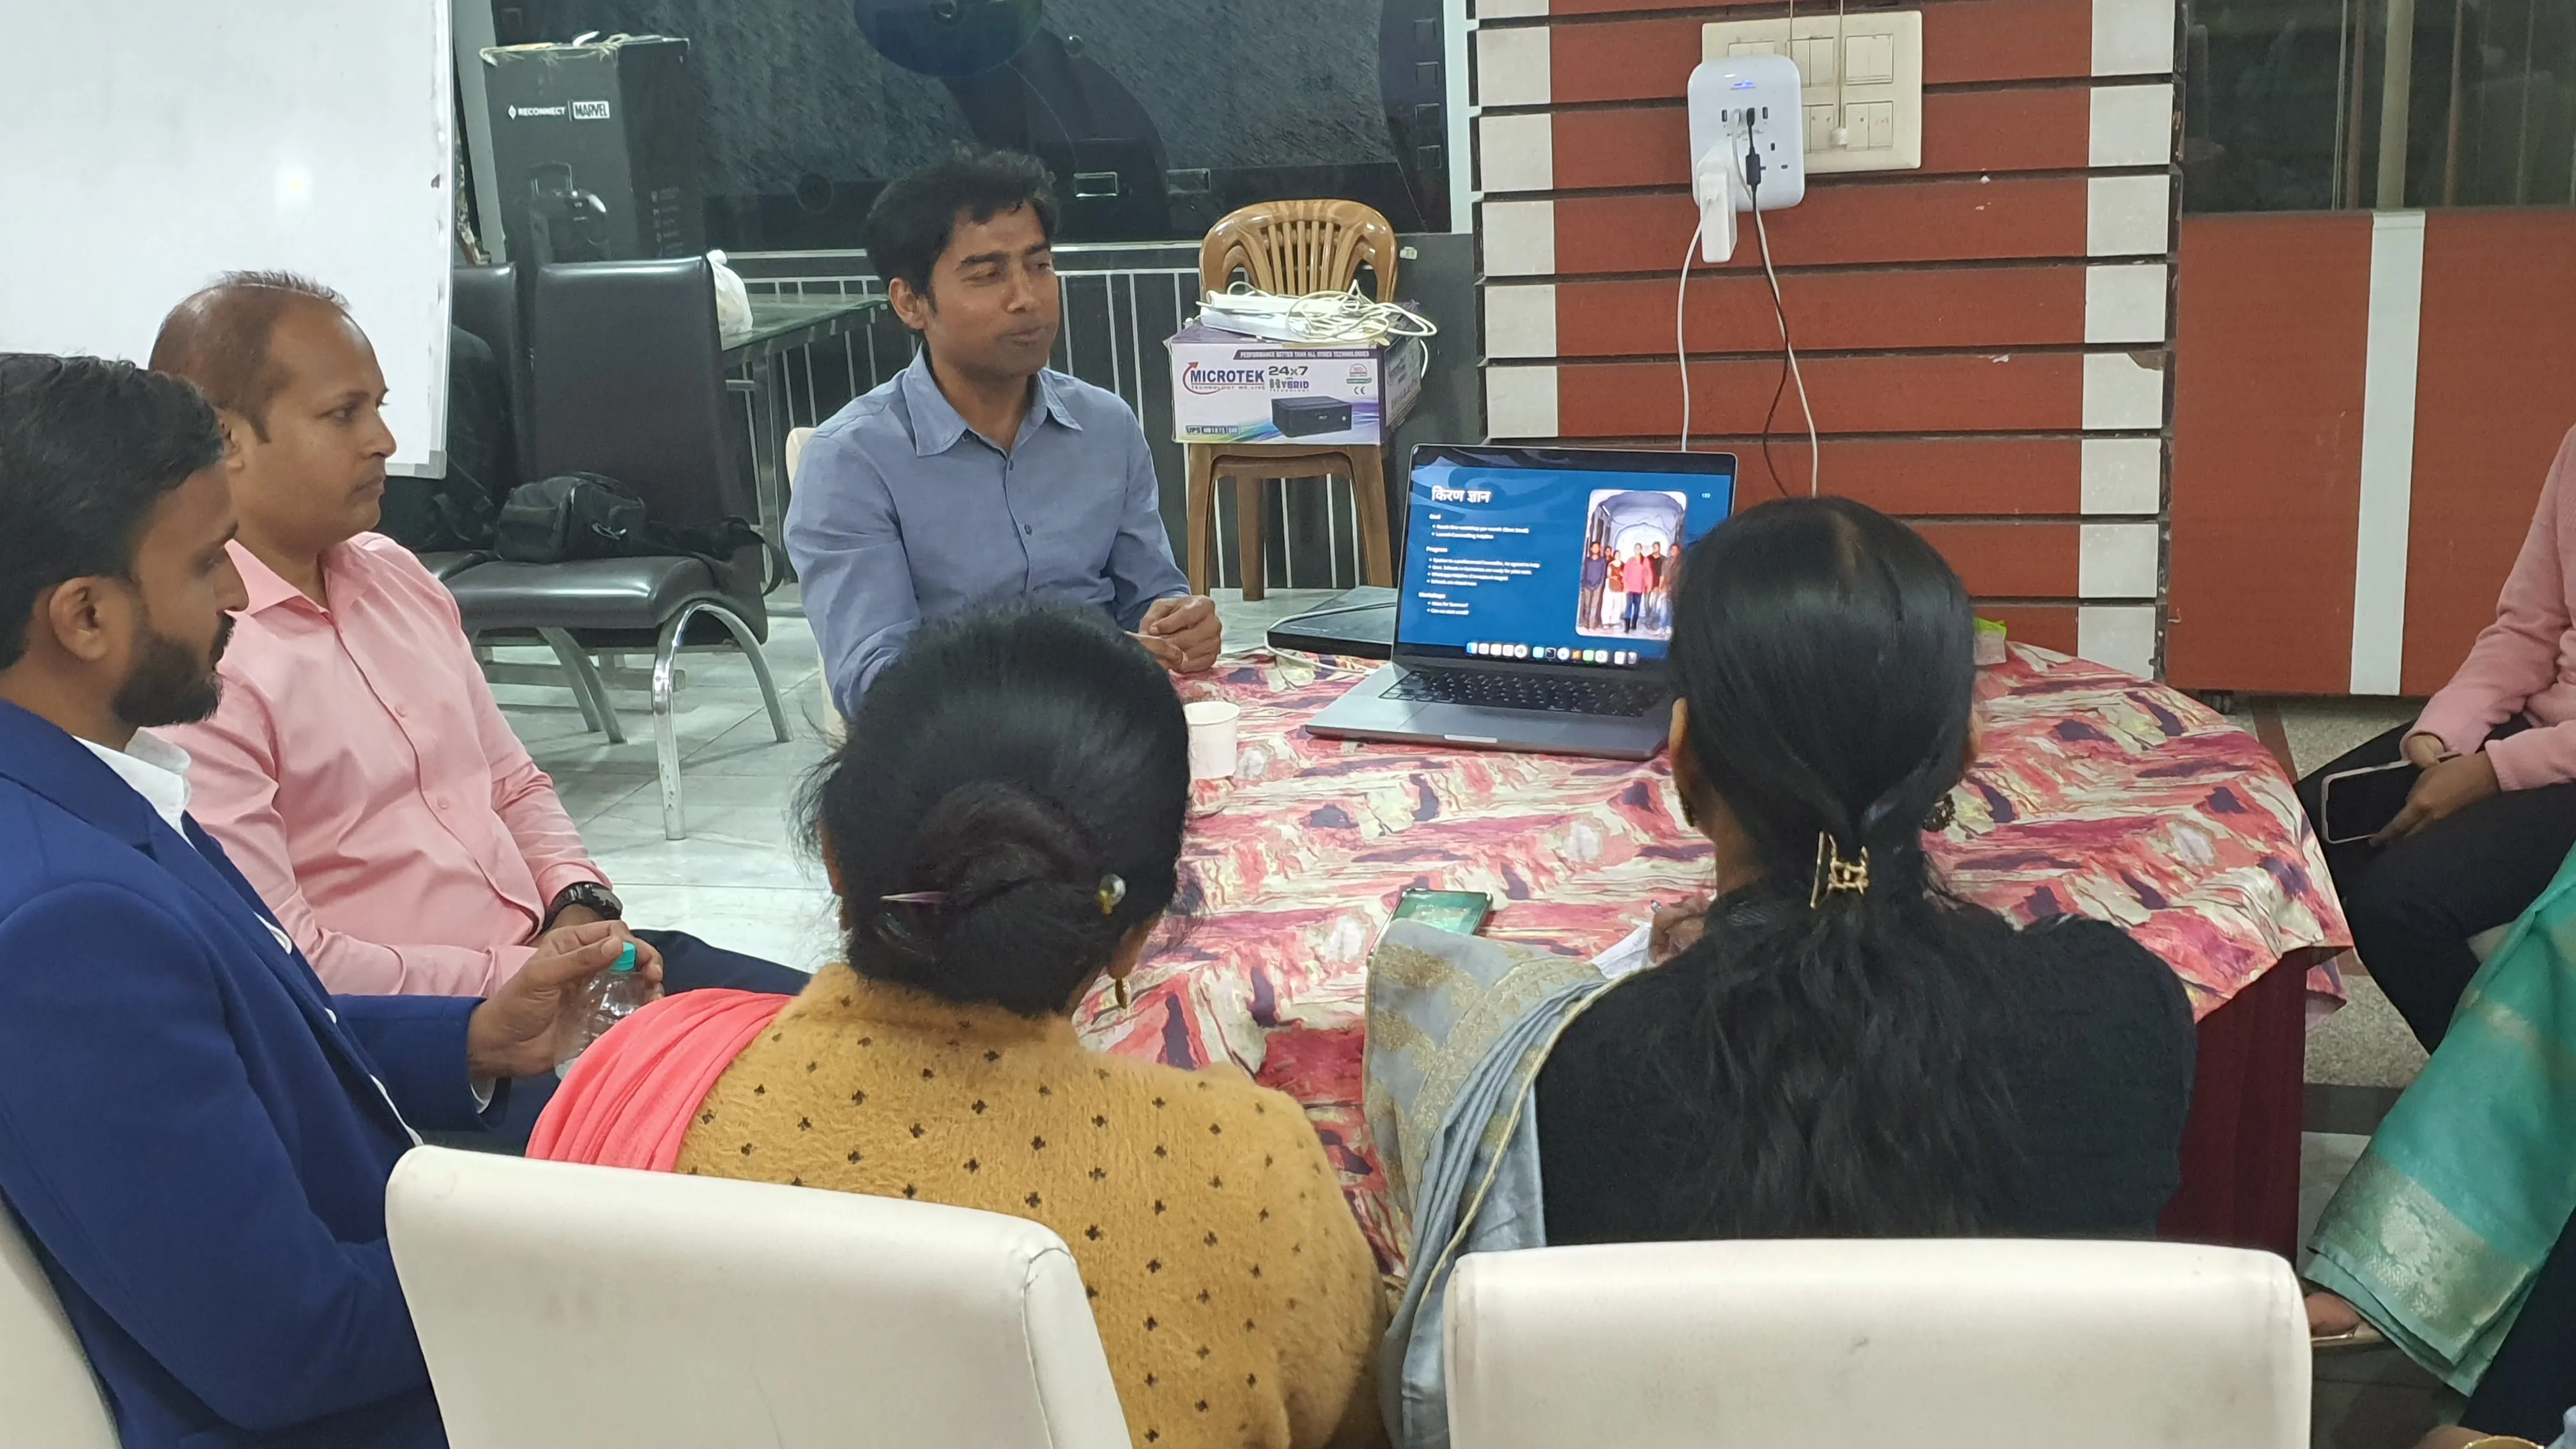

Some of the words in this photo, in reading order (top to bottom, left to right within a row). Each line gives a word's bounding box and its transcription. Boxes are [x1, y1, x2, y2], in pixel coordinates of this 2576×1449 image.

[518, 107, 565, 116] RECONNECT
[574, 103, 608, 117] MARVEL
[1190, 370, 1264, 383] MICROTEK
[1432, 485, 1465, 502] किरण
[1467, 490, 1491, 503] ज्ञान
